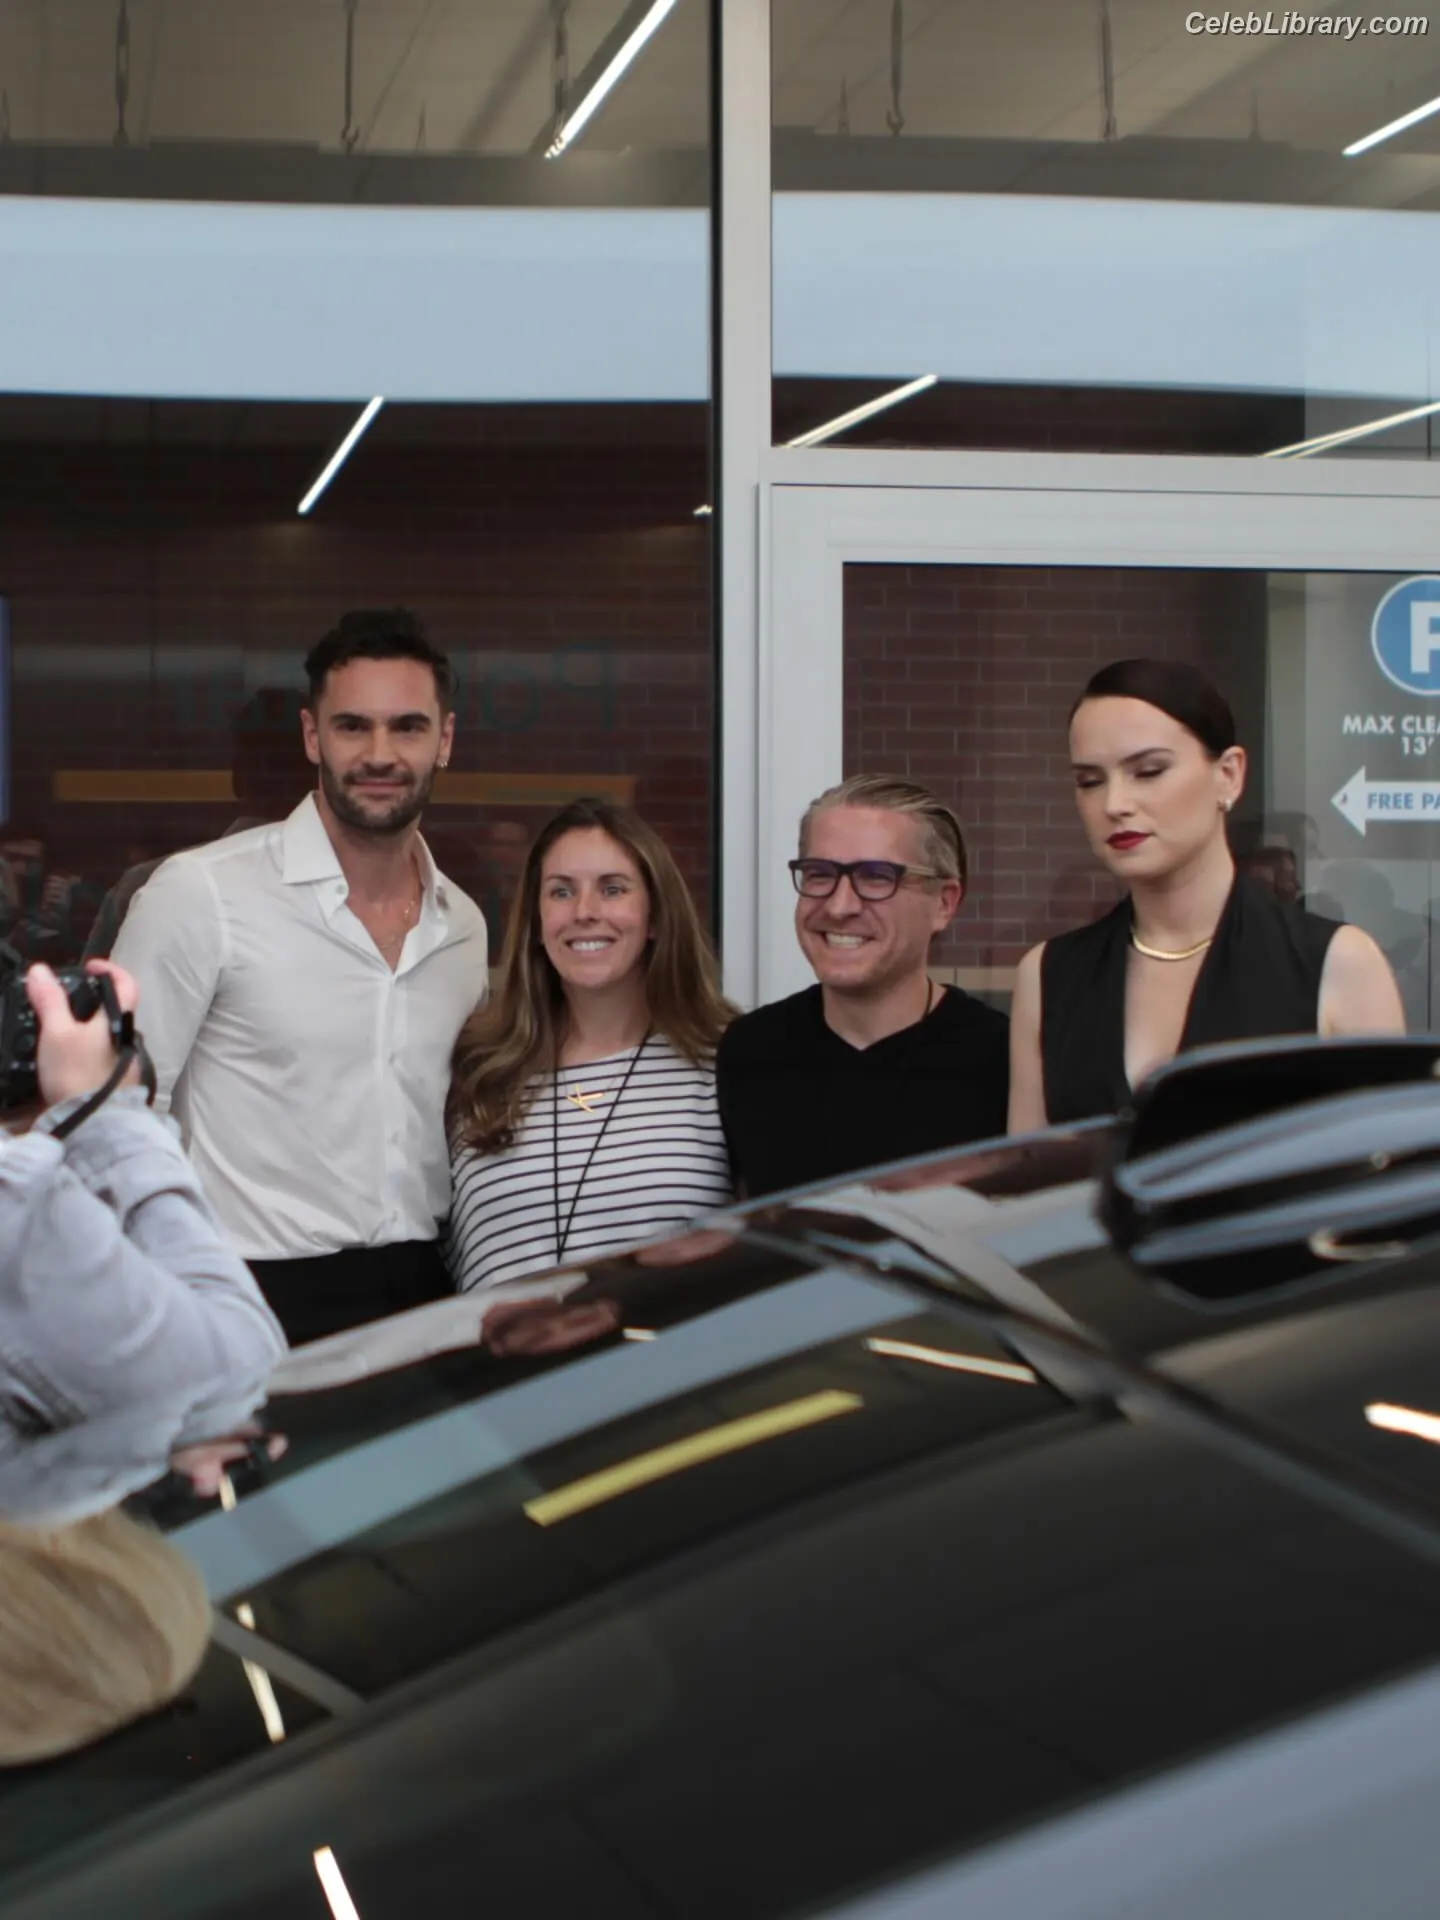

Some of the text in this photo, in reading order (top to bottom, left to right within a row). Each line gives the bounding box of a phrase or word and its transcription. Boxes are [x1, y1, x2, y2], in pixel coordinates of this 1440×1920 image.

[1342, 715, 1440, 735] MAX CLE
[1367, 792, 1414, 811] FREE
